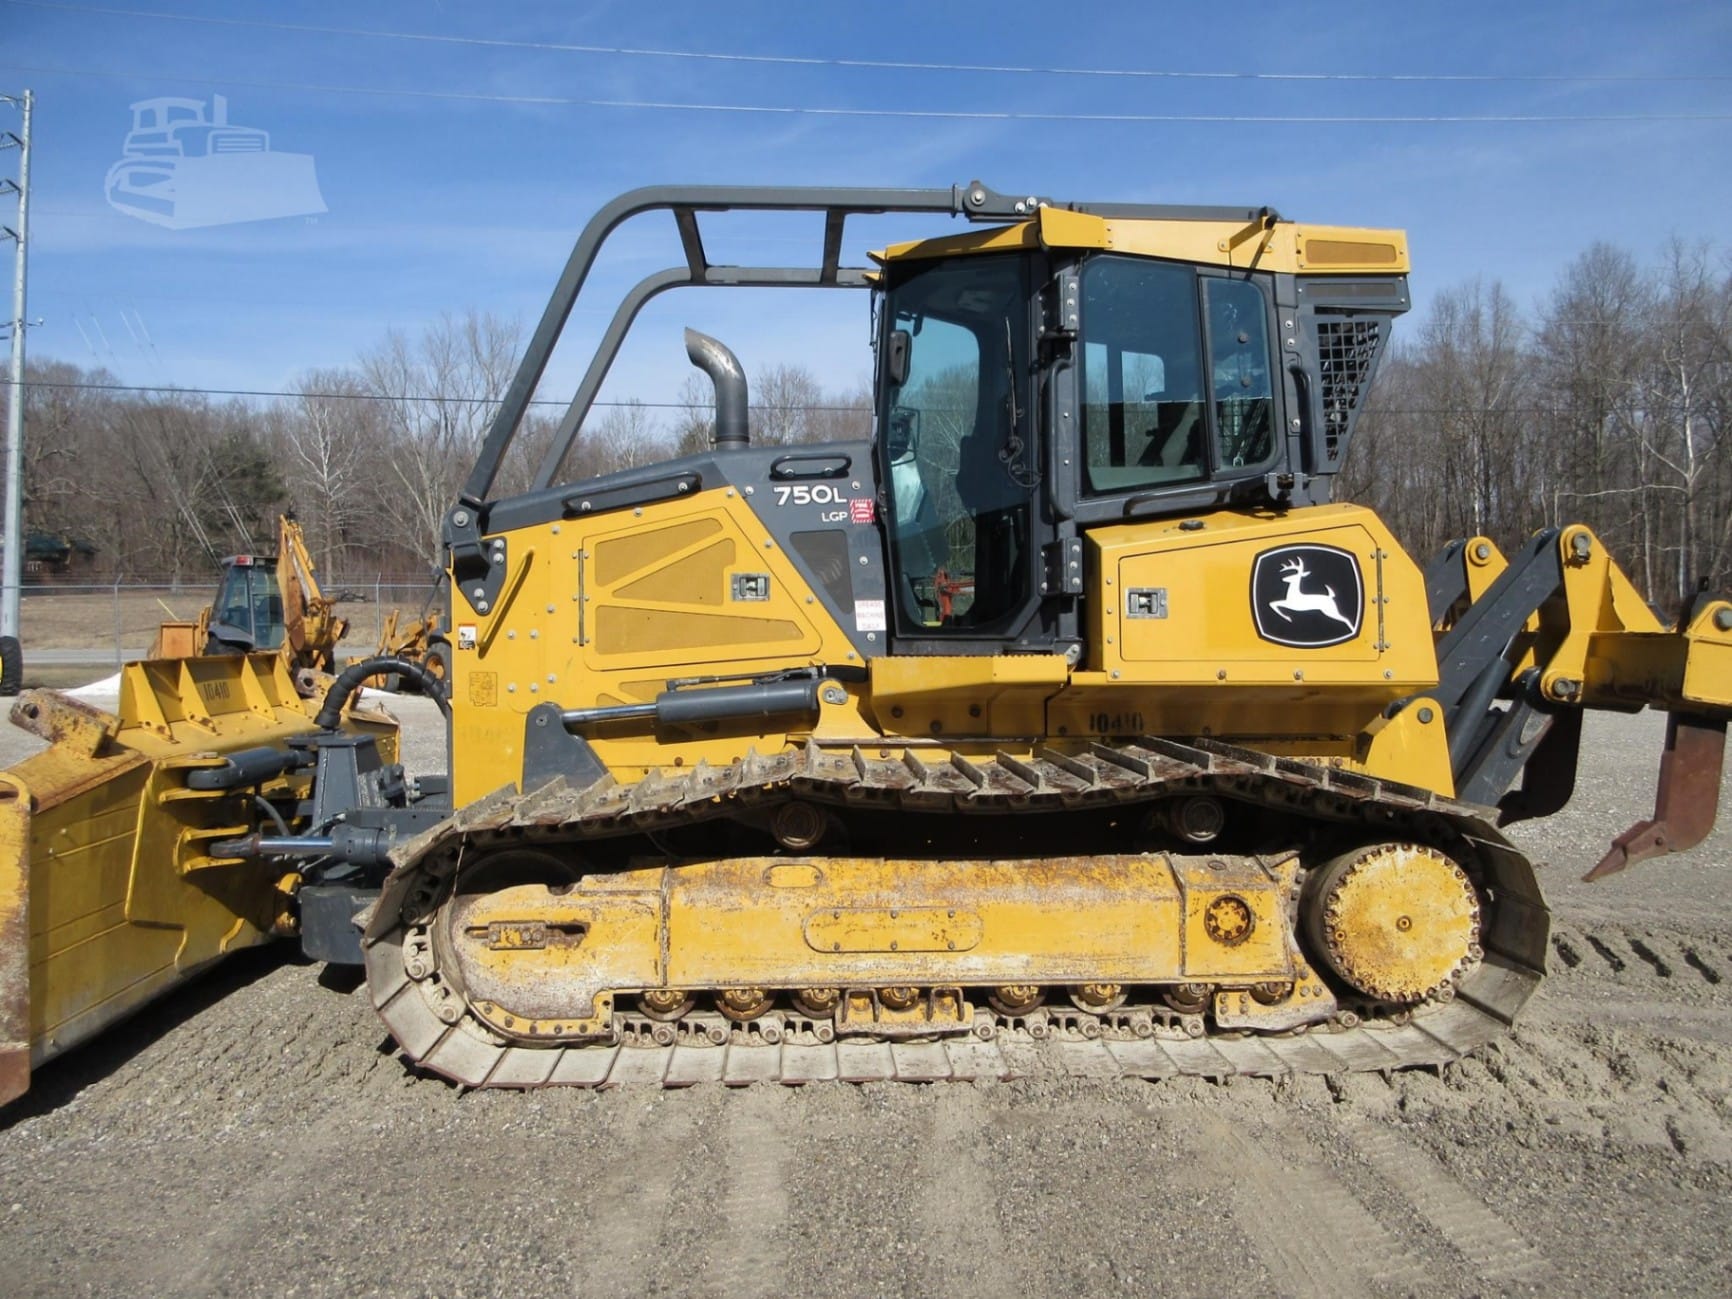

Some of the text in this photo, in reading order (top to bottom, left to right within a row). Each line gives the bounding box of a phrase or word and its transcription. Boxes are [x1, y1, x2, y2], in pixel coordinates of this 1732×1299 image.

[773, 484, 848, 506] 750L
[821, 511, 848, 522] LGP
[203, 681, 231, 701] 10410
